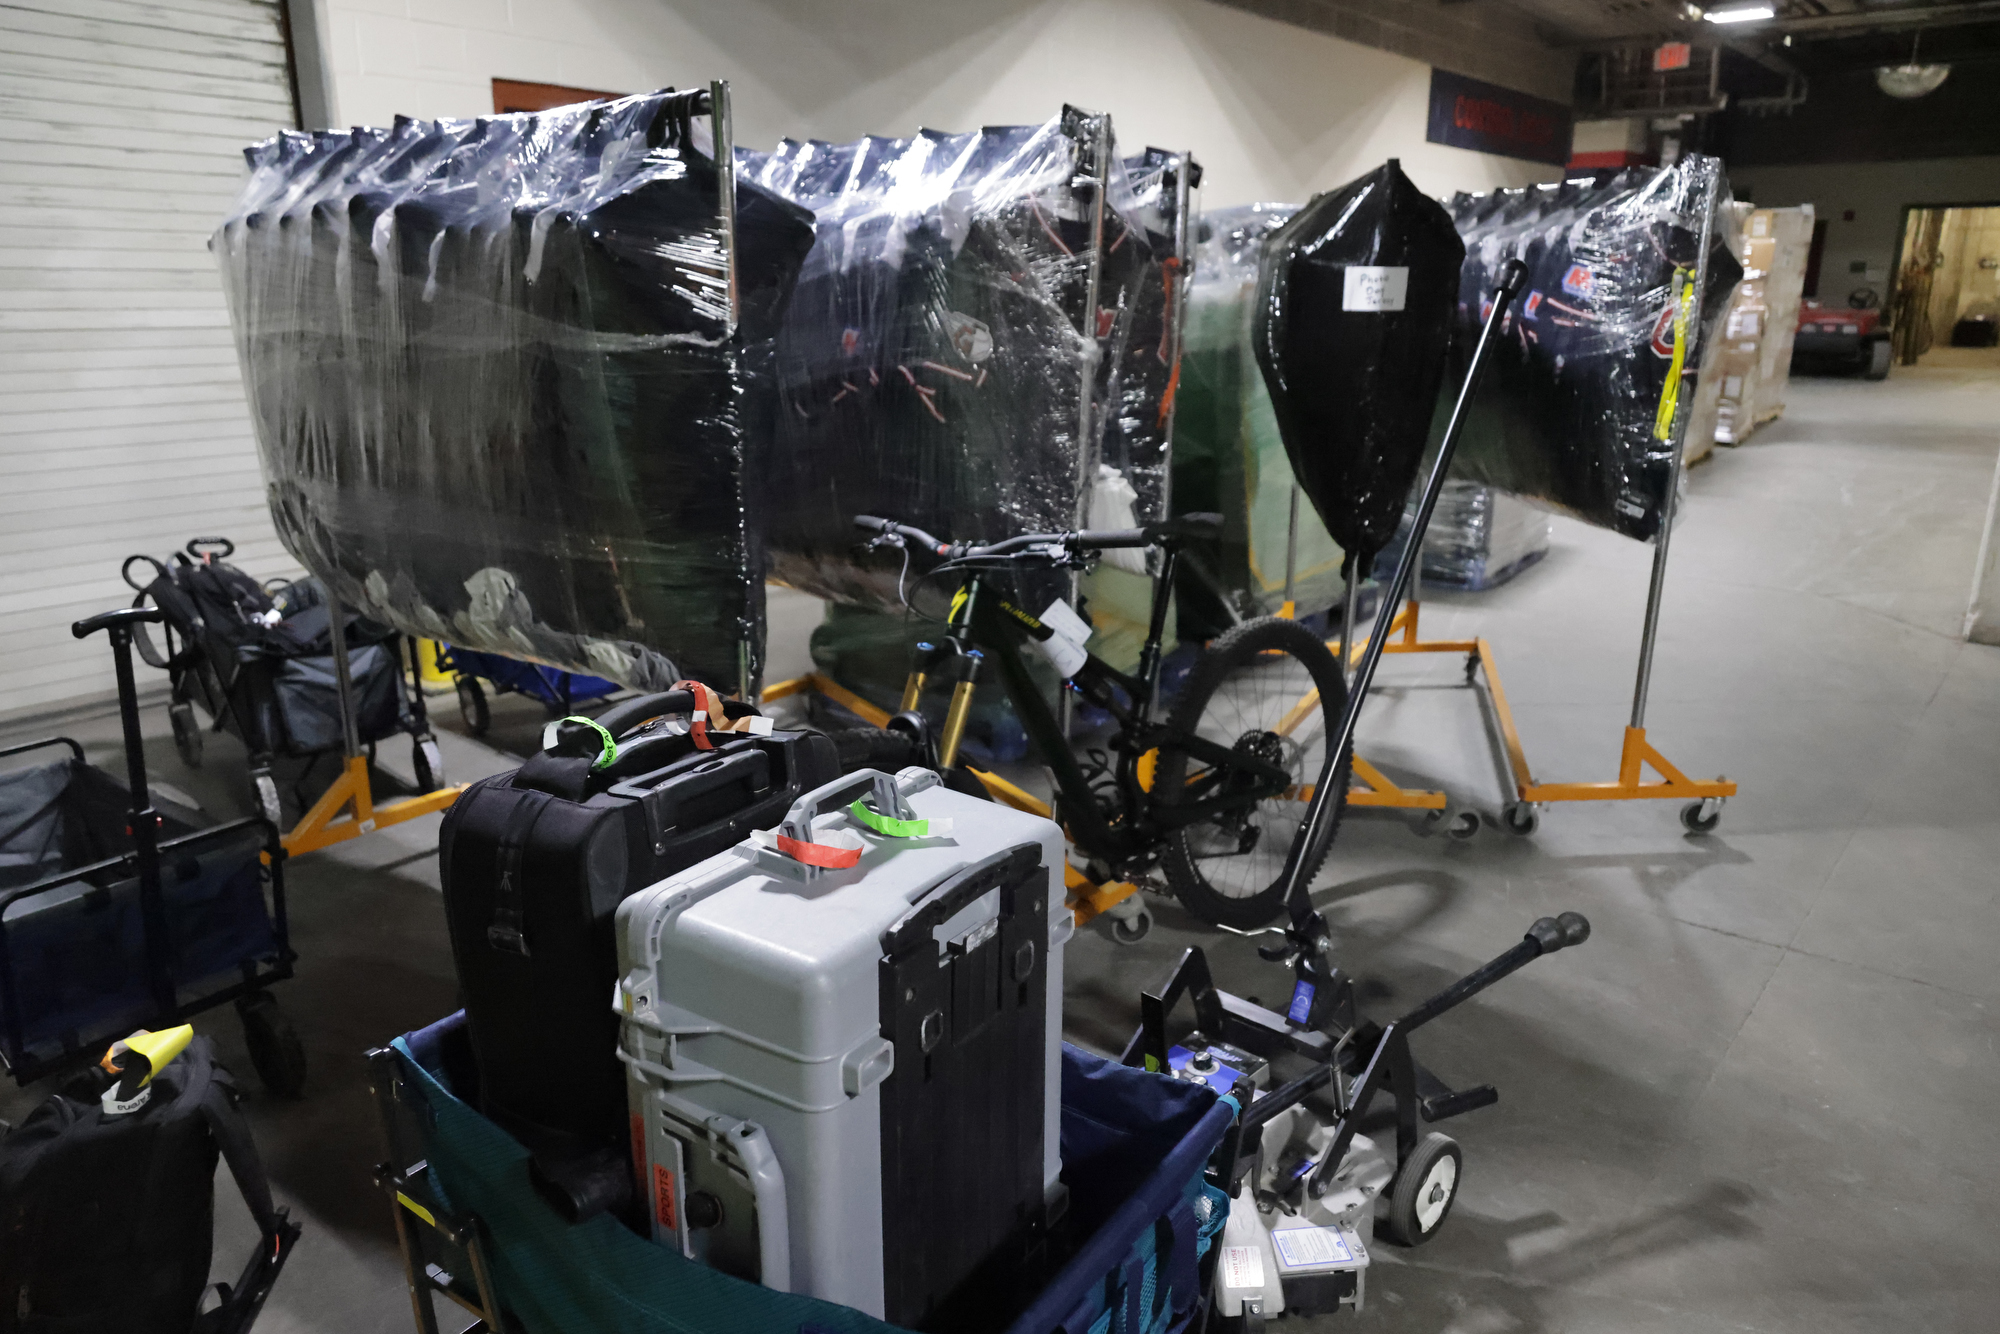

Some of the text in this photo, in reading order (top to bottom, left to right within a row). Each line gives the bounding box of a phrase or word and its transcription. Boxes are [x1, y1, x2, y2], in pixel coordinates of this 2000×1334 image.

[1360, 273, 1390, 286] Photo
[658, 1168, 672, 1227] SPORTS
[1230, 1248, 1238, 1261] USE
